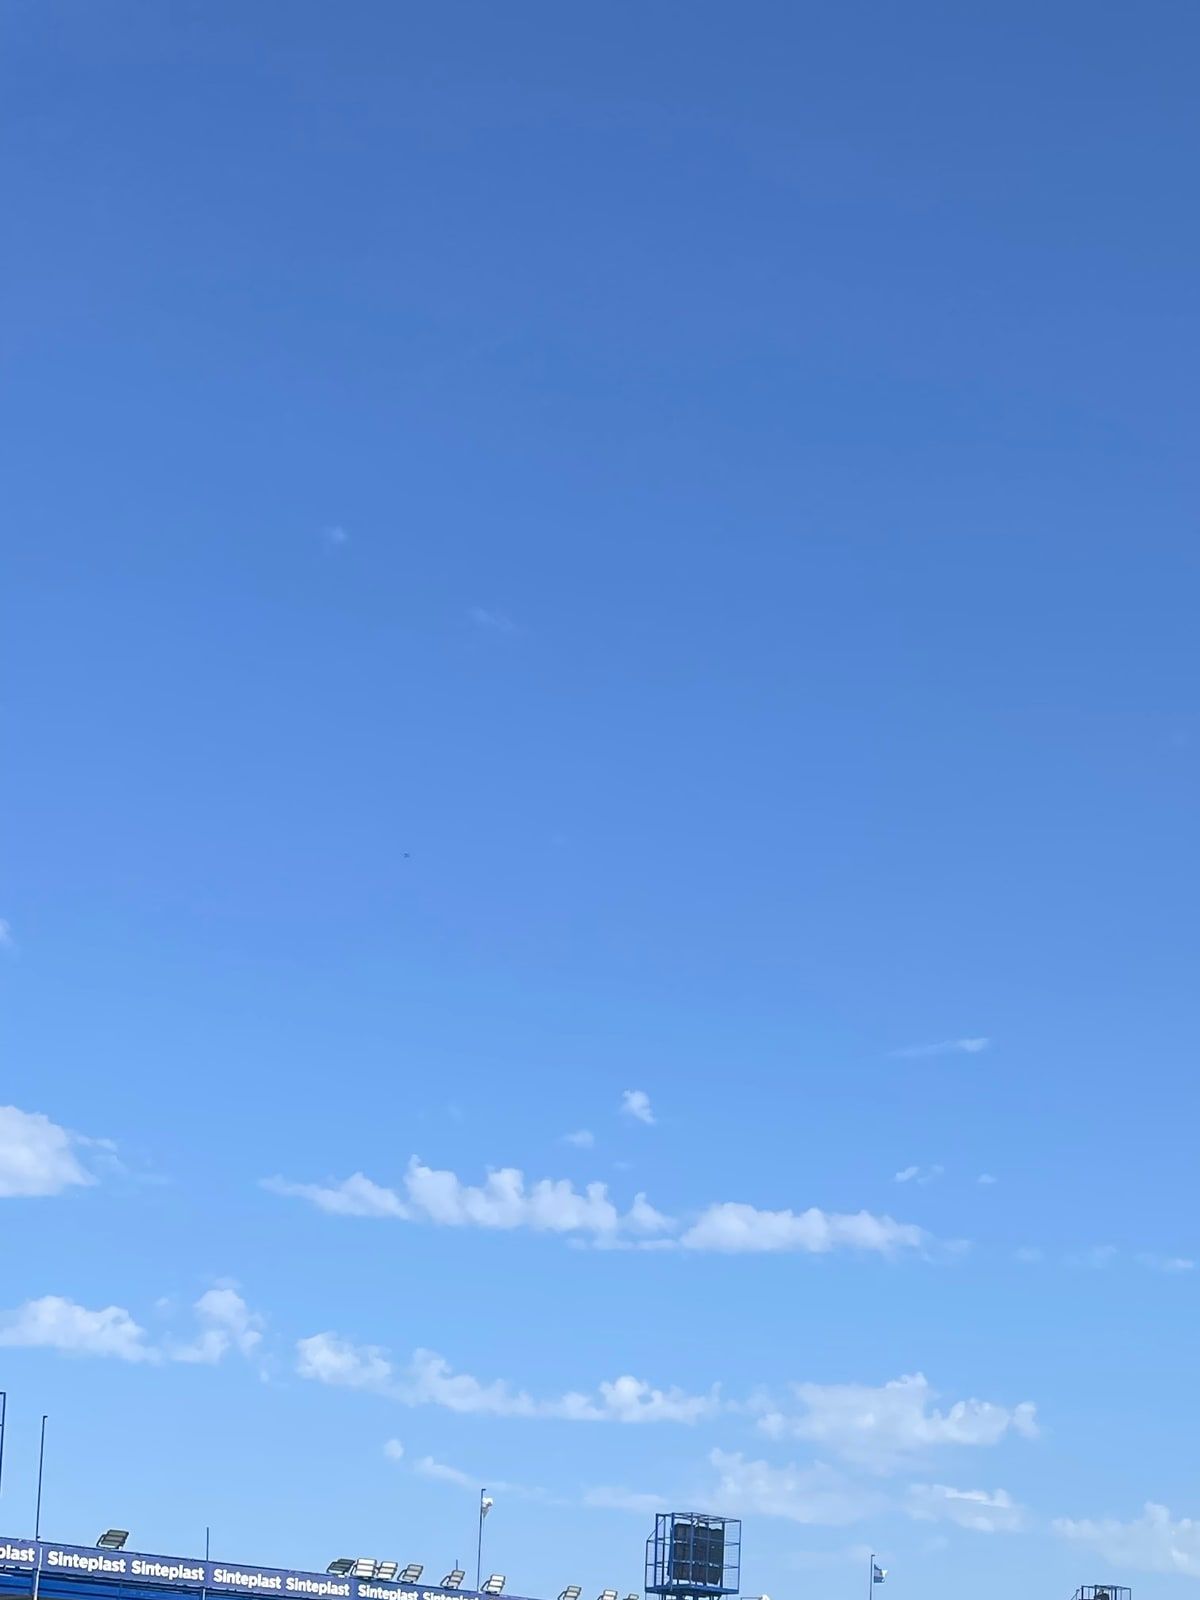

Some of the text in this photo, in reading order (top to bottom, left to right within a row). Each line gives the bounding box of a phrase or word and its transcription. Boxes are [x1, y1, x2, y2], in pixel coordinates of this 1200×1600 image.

[47, 1550, 126, 1573] Sinteplast
[131, 1560, 205, 1581] Sinteplast
[213, 1568, 282, 1591] Sinteplast
[286, 1579, 350, 1598] Sinteplast
